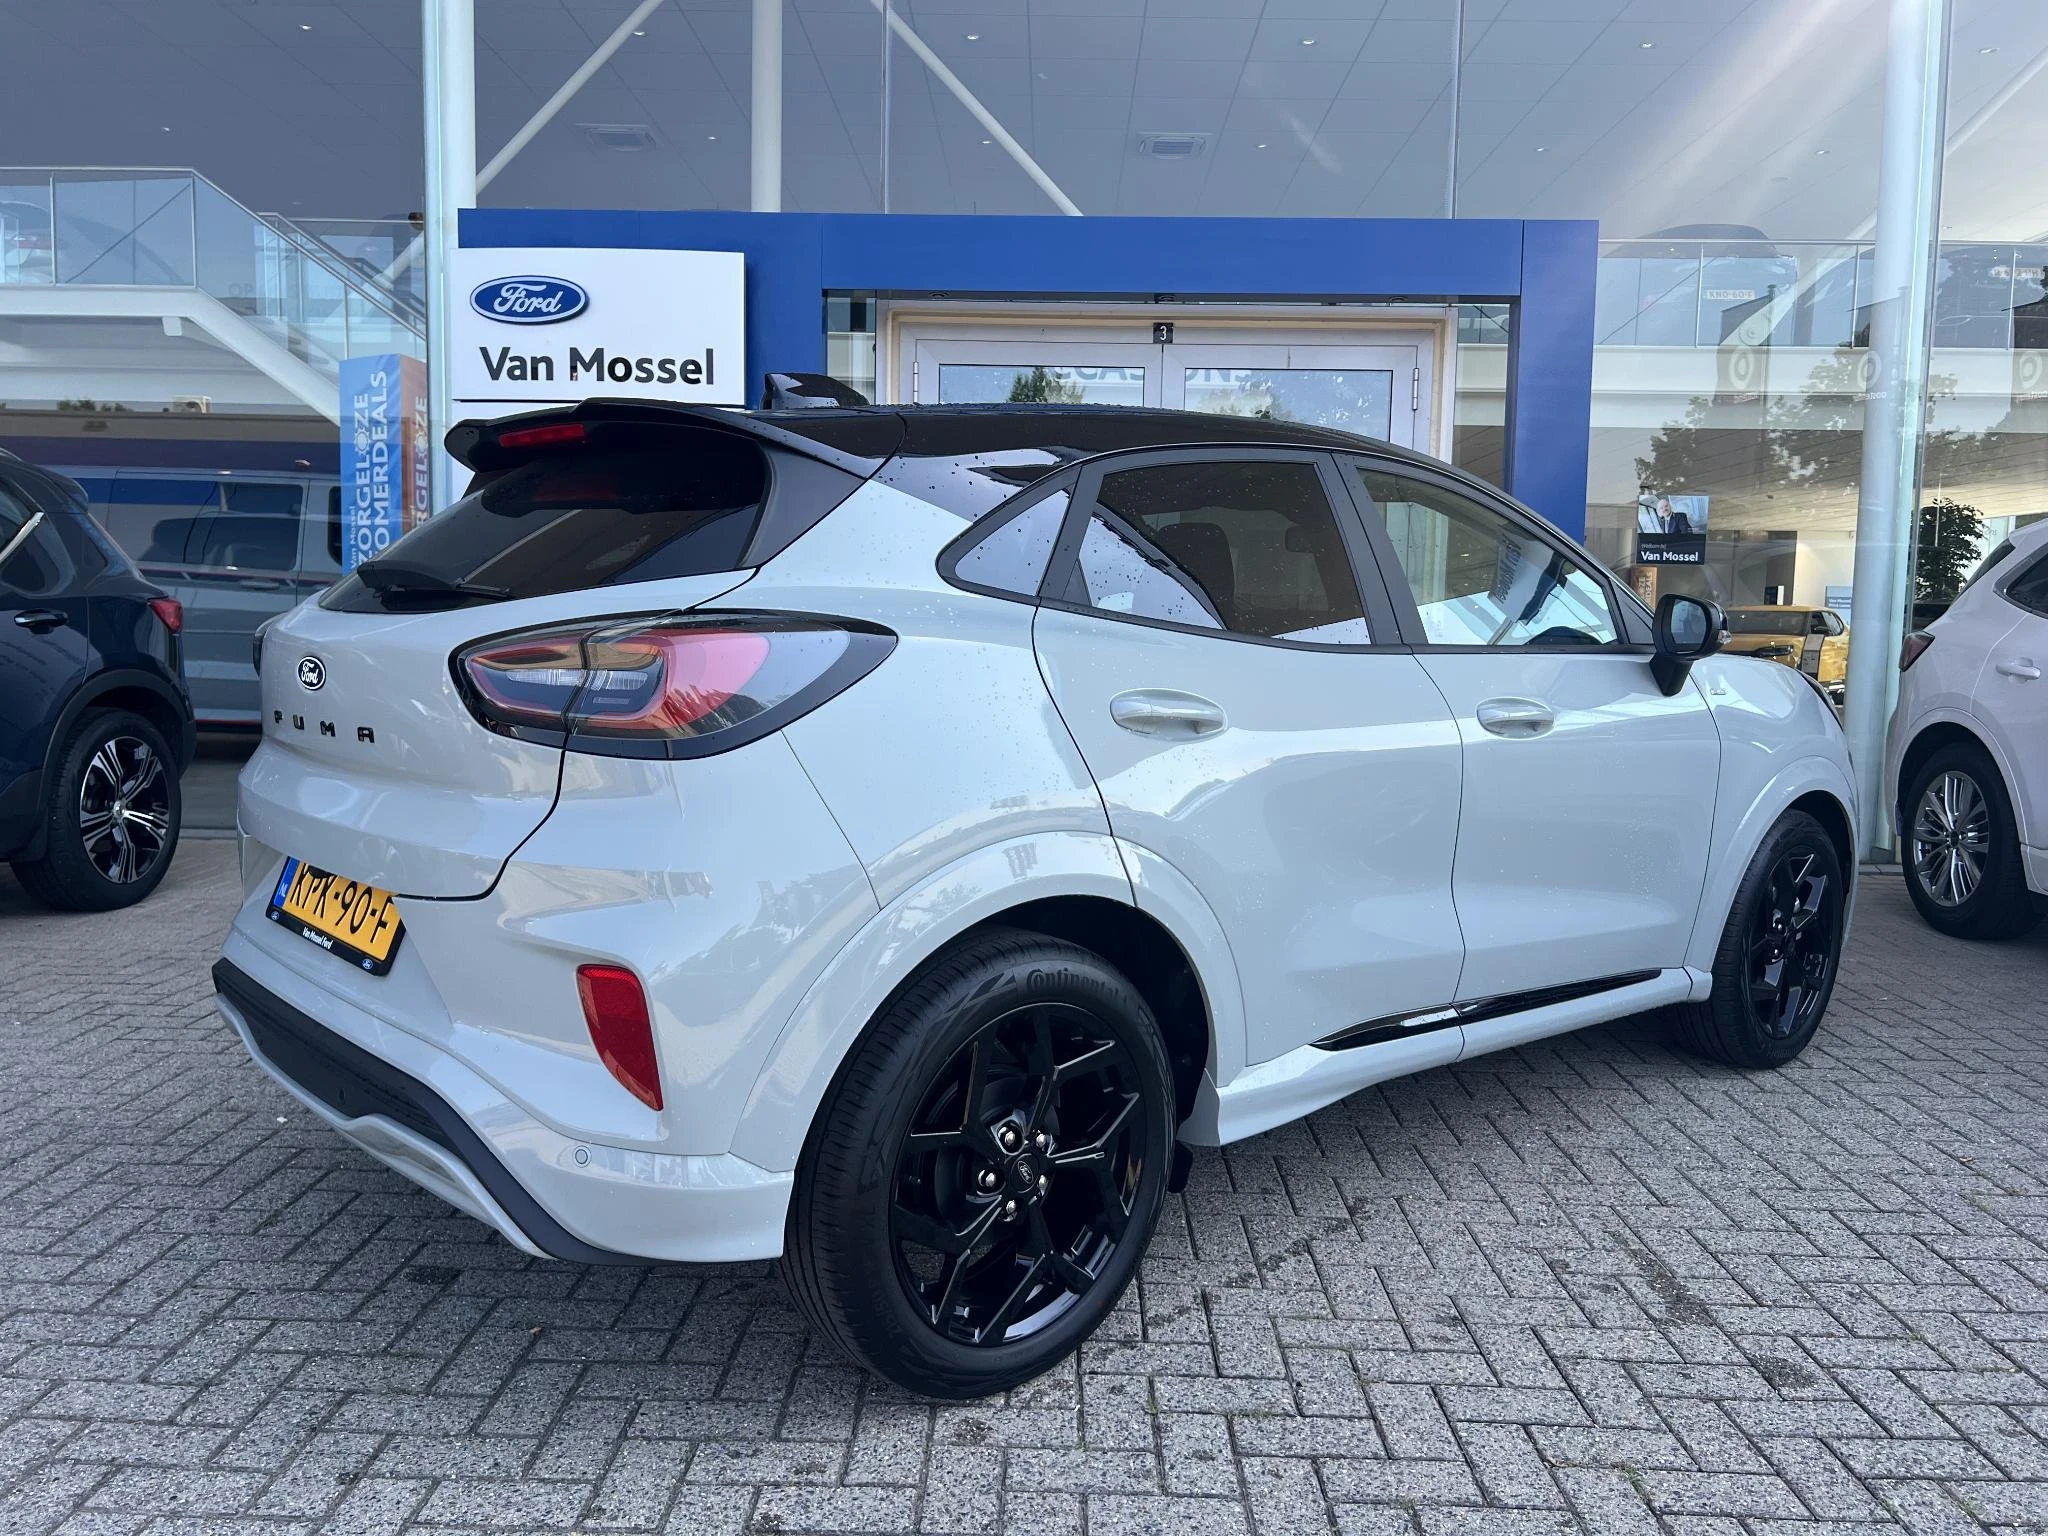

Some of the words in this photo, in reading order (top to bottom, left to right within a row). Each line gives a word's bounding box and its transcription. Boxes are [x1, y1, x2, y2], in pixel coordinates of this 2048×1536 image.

[493, 283, 563, 313] Ford
[1159, 325, 1167, 341] 3
[479, 346, 554, 381] Van
[569, 347, 714, 385] Mossel
[371, 371, 390, 554] OMERDEALS
[1641, 551, 1660, 561] Van
[1662, 551, 1698, 562] Mossel
[301, 661, 319, 684] Ford
[274, 710, 375, 743] PUMA
[302, 926, 311, 938] Van
[309, 930, 325, 945] Mossel
[322, 937, 334, 949] Ford
